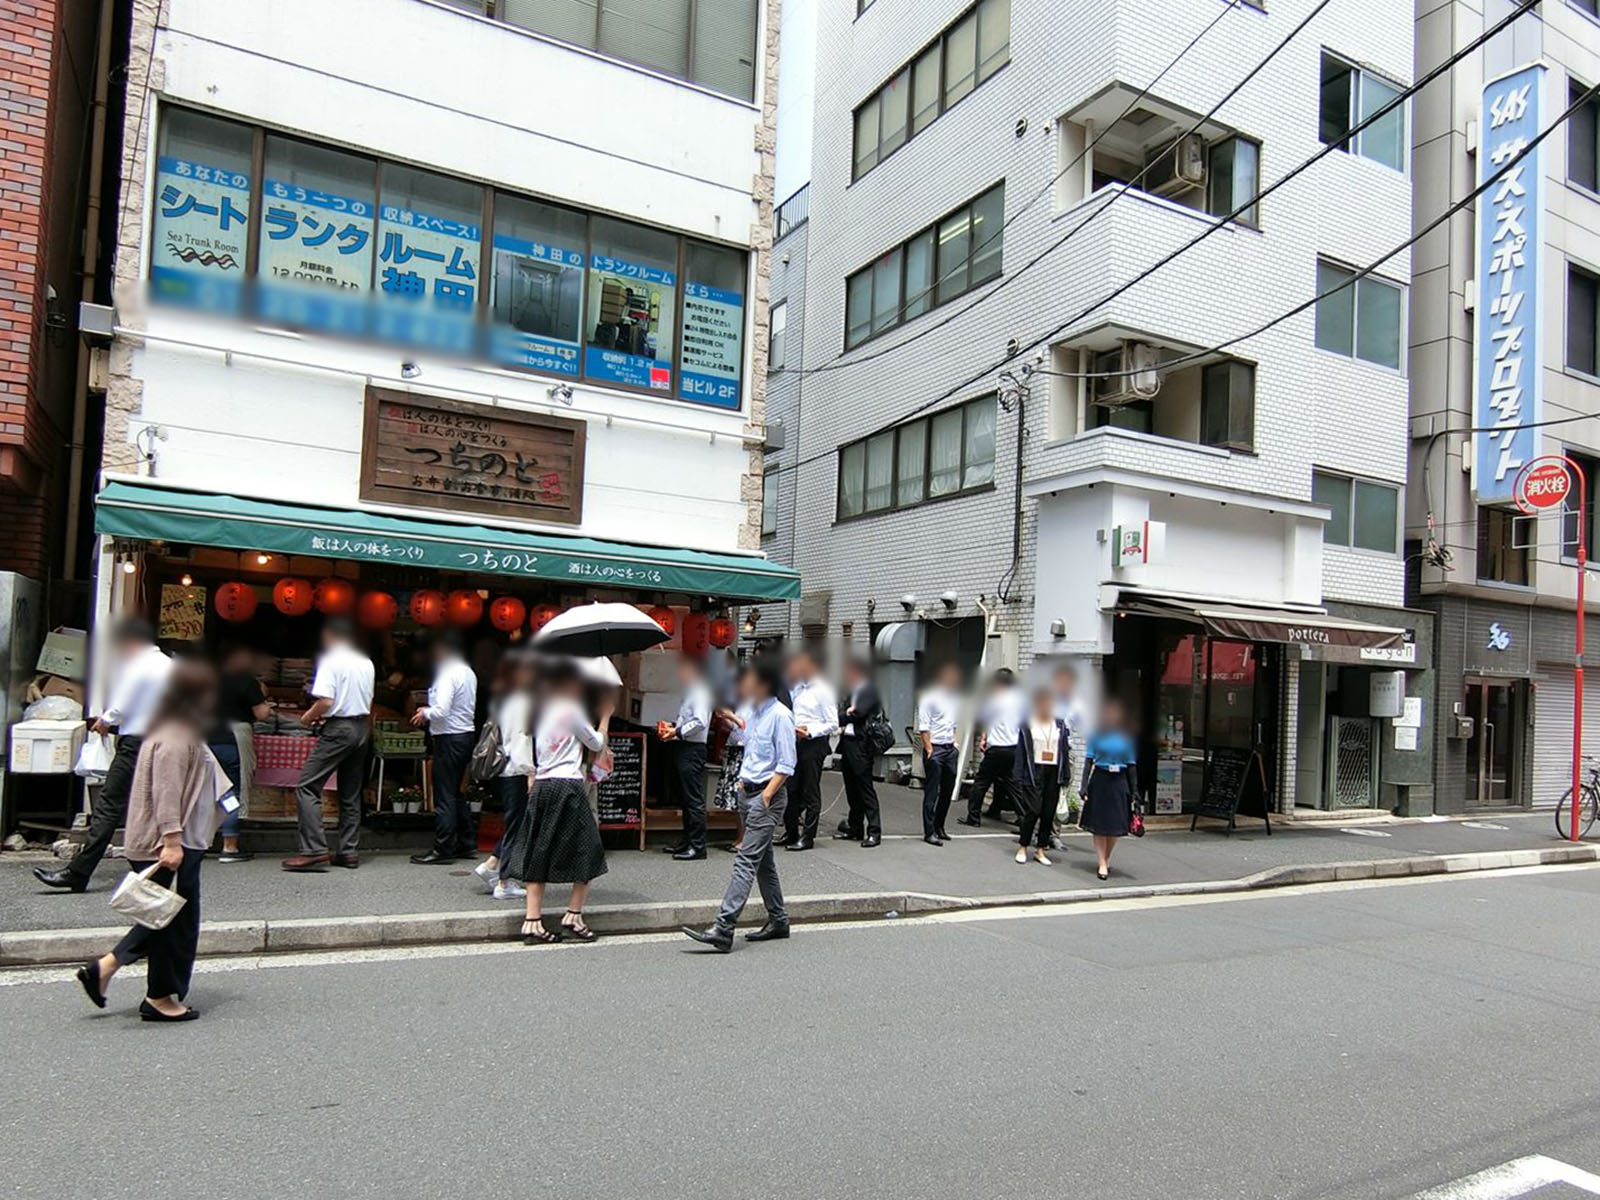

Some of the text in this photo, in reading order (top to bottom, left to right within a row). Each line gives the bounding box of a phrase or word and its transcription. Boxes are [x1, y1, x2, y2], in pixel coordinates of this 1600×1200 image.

[1490, 83, 1532, 130] SAS
[175, 160, 248, 189] あなたの
[273, 182, 366, 216] もう一つの
[160, 184, 475, 280] シート ランク ルーム
[167, 230, 239, 253] Sea Trunk Room
[533, 244, 581, 265] 神田の
[594, 256, 672, 285] トランクルーム
[682, 377, 716, 396] 当ビル
[718, 385, 736, 398] 2F
[405, 441, 539, 484] つちのと
[1526, 476, 1567, 497] 消火栓
[312, 536, 662, 582] 飯は人の体をつくり つちのと 酒は人の心をつくる
